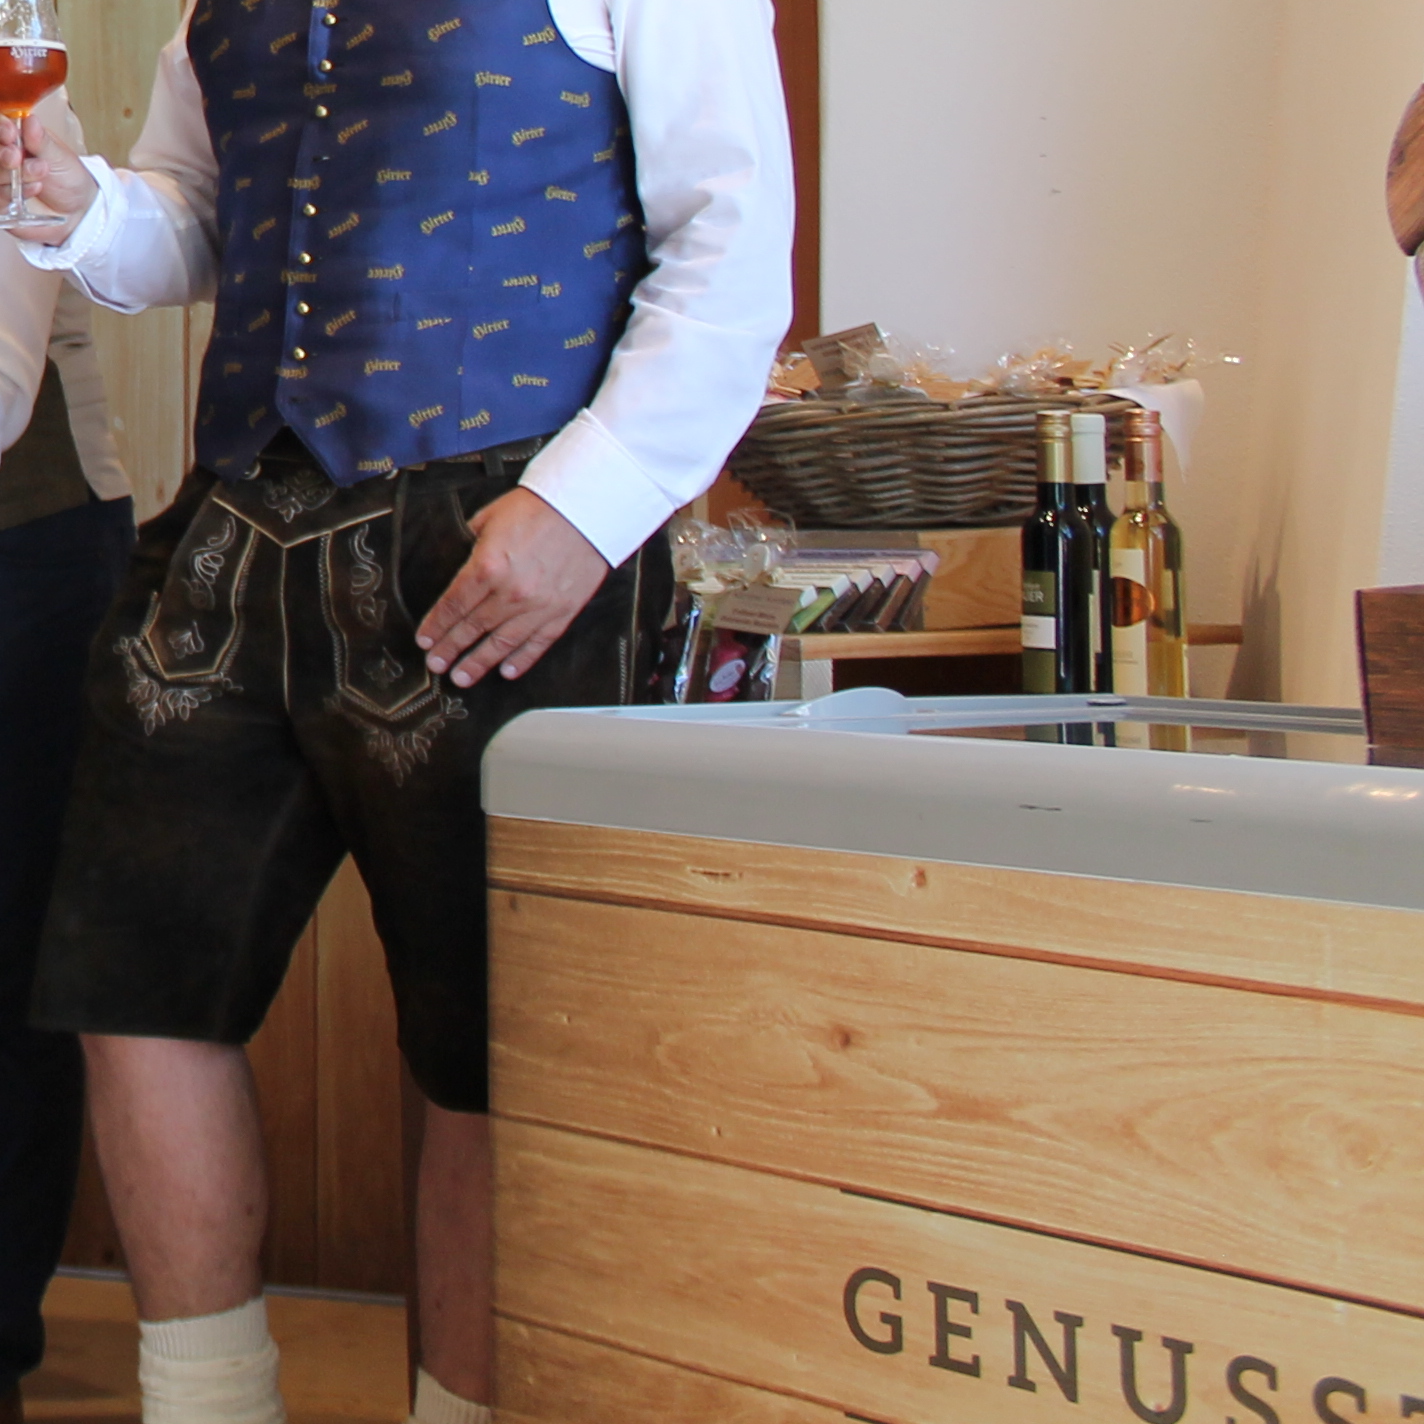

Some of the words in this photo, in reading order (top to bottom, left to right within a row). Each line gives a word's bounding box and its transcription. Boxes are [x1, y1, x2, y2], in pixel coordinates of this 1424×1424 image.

[10, 45, 49, 59] Hirter
[475, 71, 513, 87] Hirter
[420, 210, 455, 236] Hirter
[472, 319, 510, 341] Hirter
[363, 359, 402, 376] Hirter
[408, 404, 444, 429] Hirter
